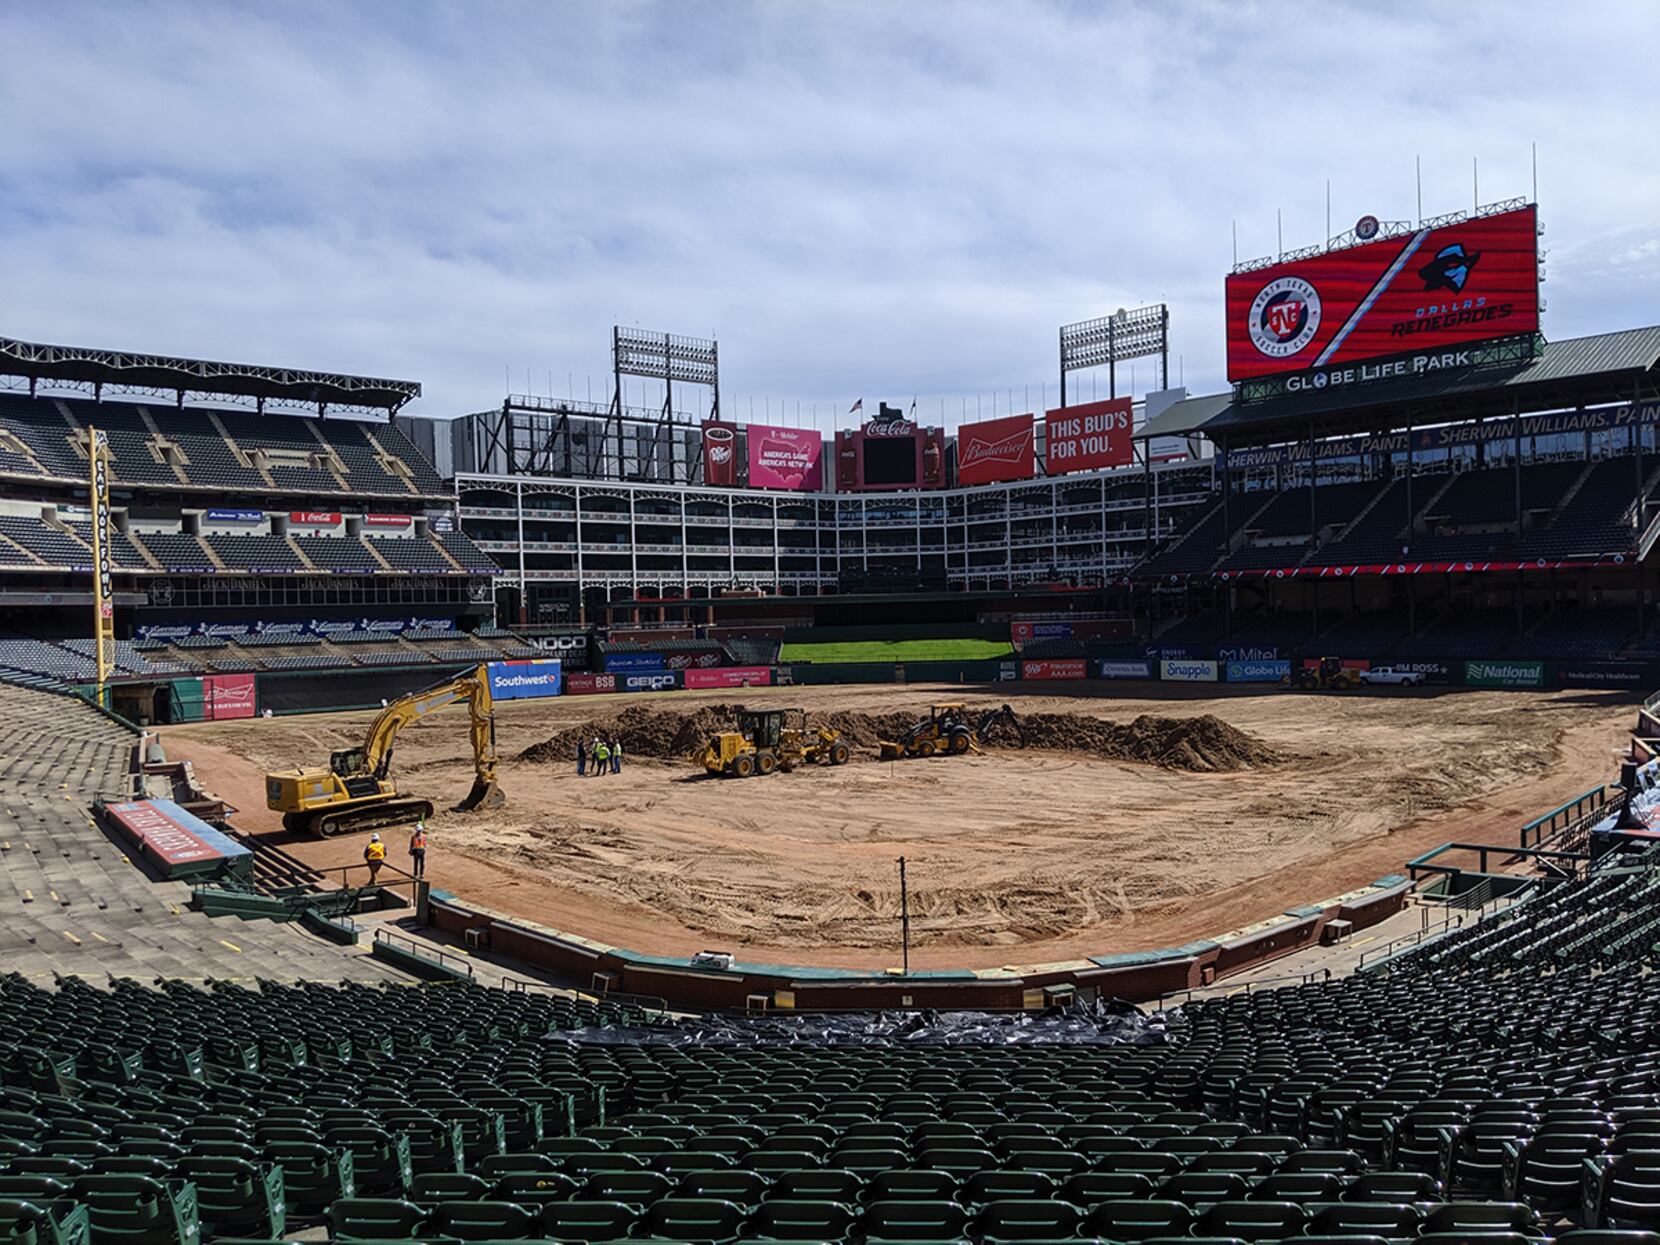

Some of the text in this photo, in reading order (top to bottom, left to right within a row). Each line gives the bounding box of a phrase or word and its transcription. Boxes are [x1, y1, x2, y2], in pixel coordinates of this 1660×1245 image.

[1415, 297, 1486, 318] DALLAS
[1391, 303, 1513, 338] RENEGADES
[1362, 361, 1406, 380] LIFE
[1413, 351, 1469, 374] PARK
[1051, 411, 1128, 439] THIS BUD'S
[967, 441, 1025, 460] Budweiser
[1051, 436, 1113, 460] FOR YOU.
[97, 460, 105, 497] EAT
[99, 503, 107, 541] MOR
[101, 549, 110, 597] FOWL
[1240, 647, 1277, 660] Mitel
[1167, 662, 1211, 678] Snapple
[1244, 665, 1274, 676] Globe
[1412, 663, 1440, 673] ROSS
[1483, 665, 1540, 678] National
[495, 675, 548, 687] Southwest
[596, 676, 615, 688] BSB
[627, 675, 674, 687] GEICO
